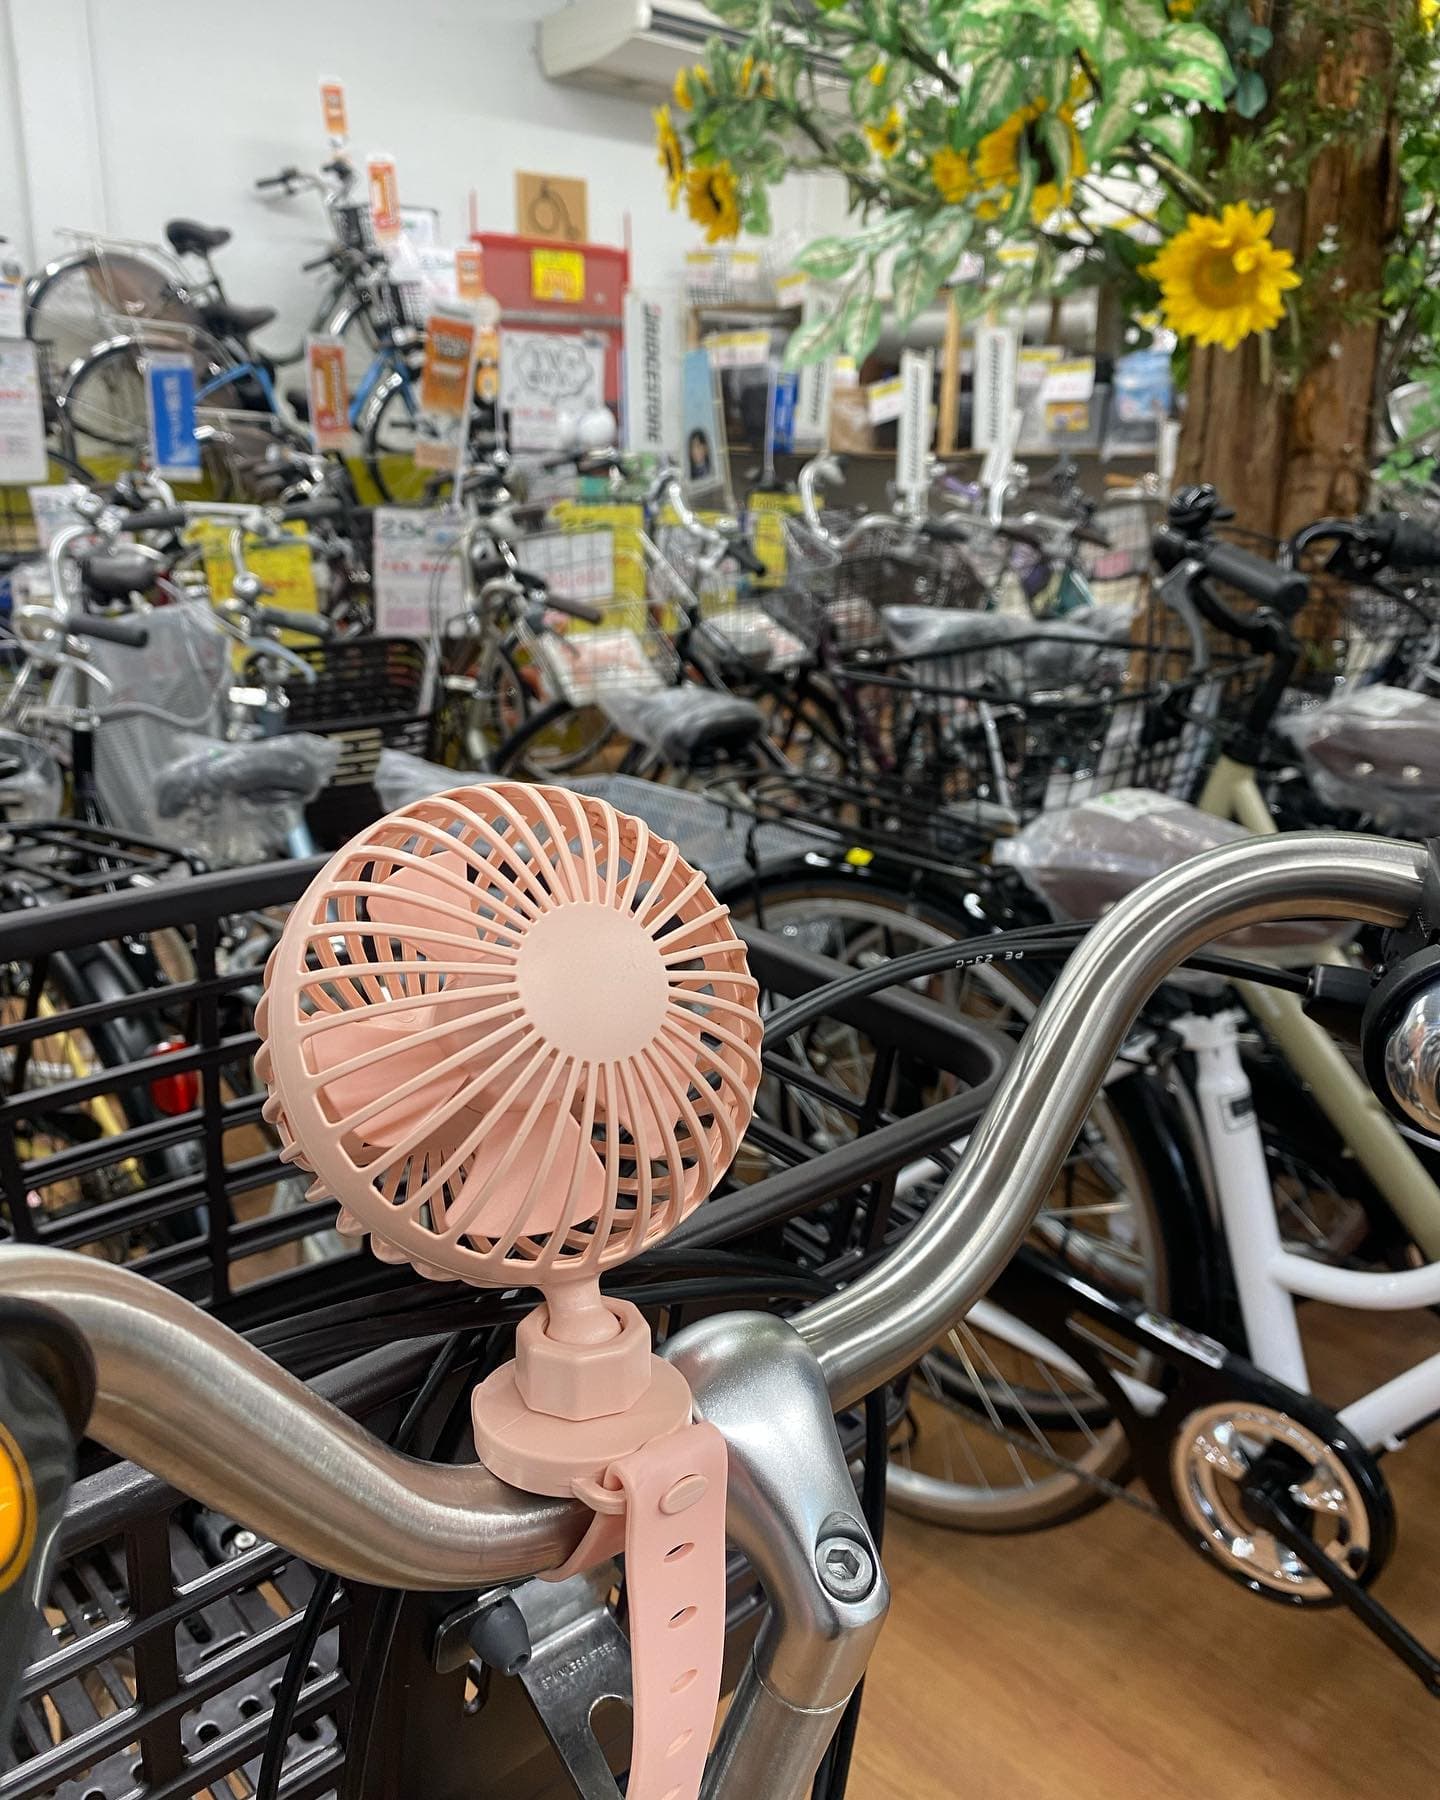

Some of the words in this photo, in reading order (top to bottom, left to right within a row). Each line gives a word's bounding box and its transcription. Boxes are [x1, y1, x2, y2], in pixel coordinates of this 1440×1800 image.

[640, 302, 662, 444] BRIDGESTONE
[1004, 950, 1024, 960] PE
[588, 1641, 617, 1662] STEEL
